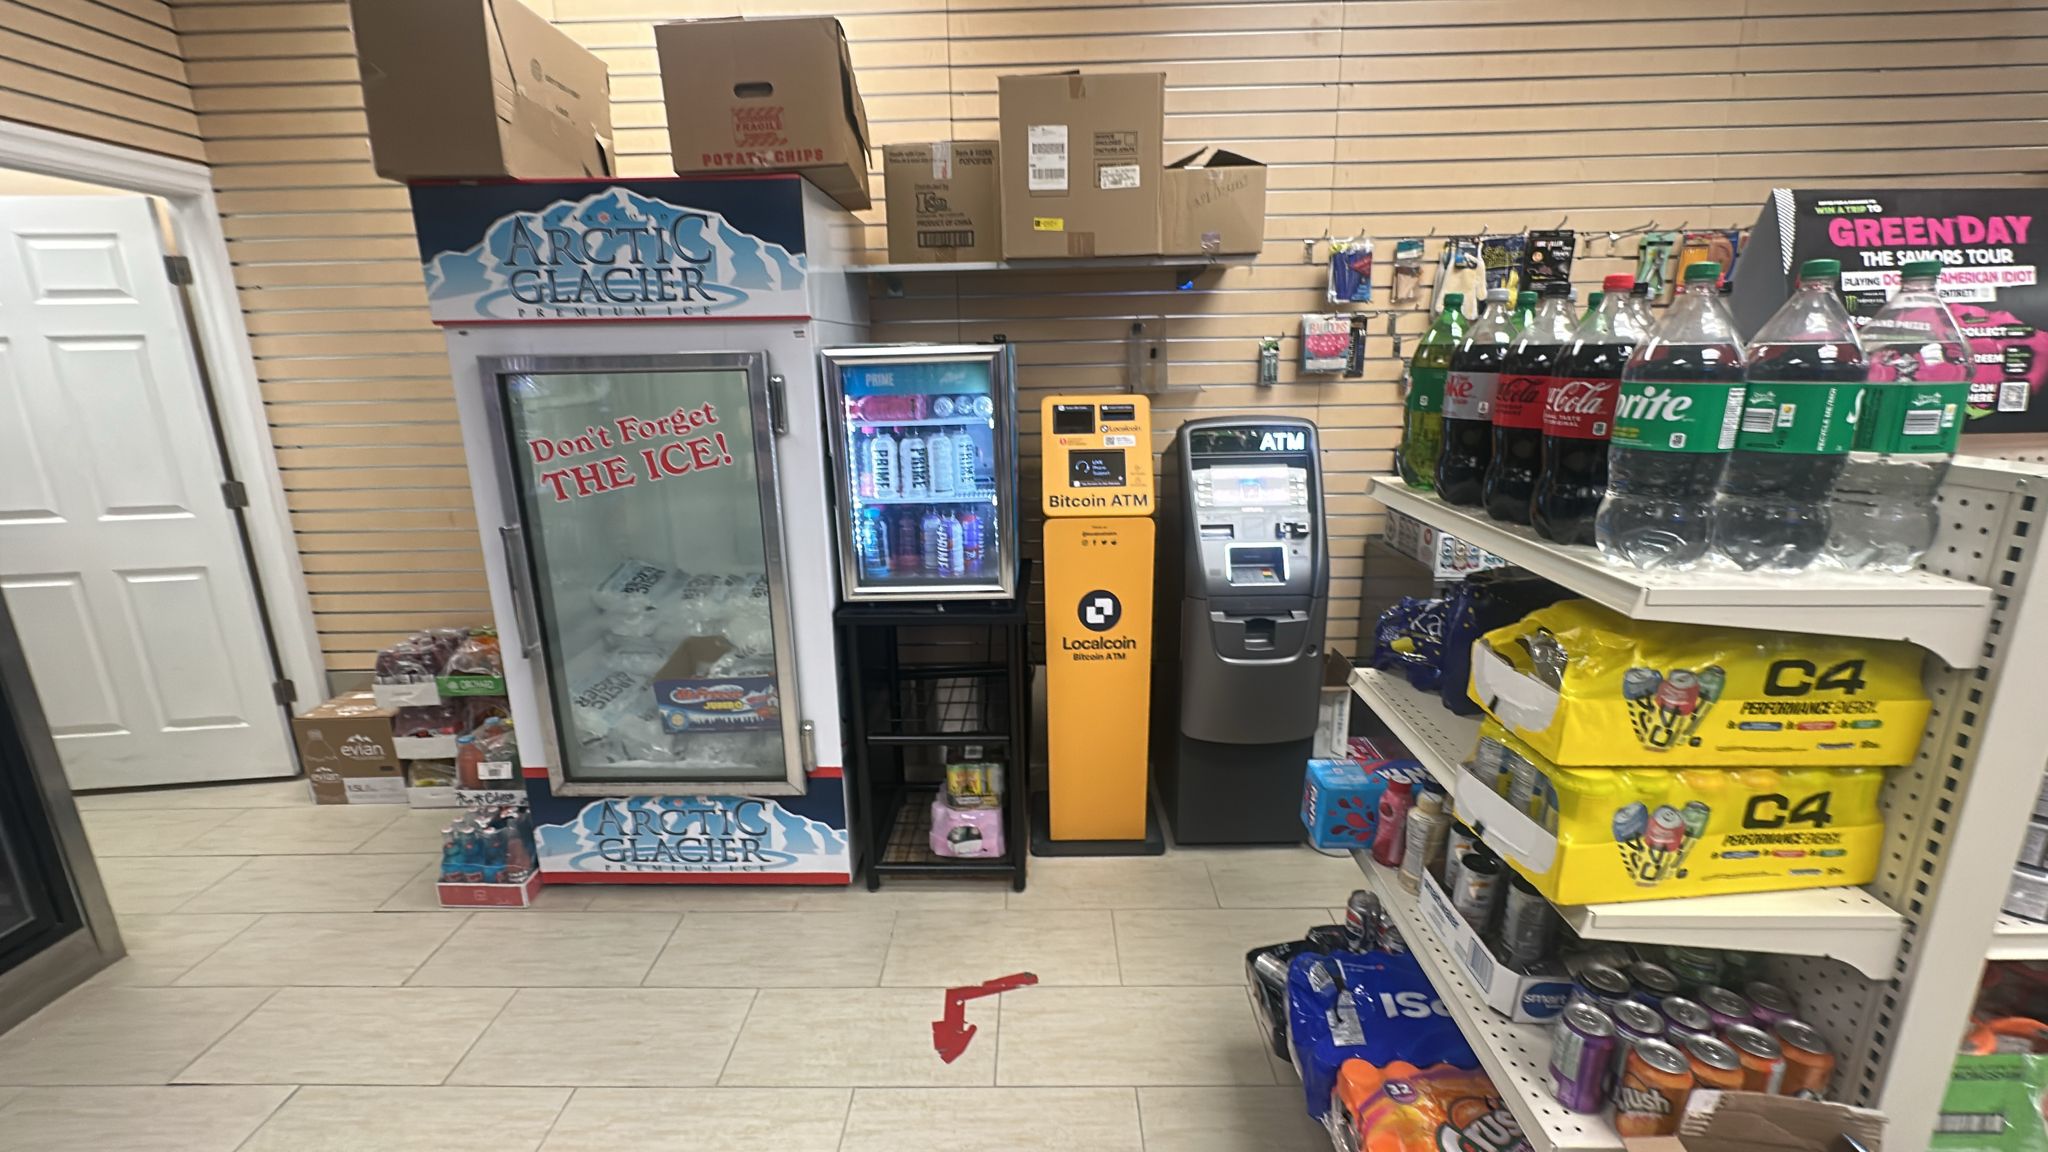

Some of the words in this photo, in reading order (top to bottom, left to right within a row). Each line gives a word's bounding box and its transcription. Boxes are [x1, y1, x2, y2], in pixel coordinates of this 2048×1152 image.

[735, 120, 783, 132] FRAGILE
[774, 148, 823, 163] CHIPS
[1815, 206, 1837, 215] WIN
[1867, 204, 1883, 213] TO
[1828, 217, 1955, 247] GREEN
[1955, 215, 2032, 245] DAY
[503, 213, 713, 266] ARCTIC
[1860, 252, 1893, 267] THE
[1898, 249, 1963, 265] SAVIORS
[1966, 249, 2014, 264] TOUR
[1844, 278, 1881, 287] PLAYING
[1940, 270, 1999, 285] AMERICAN
[2001, 269, 2034, 283] IDIOT
[509, 267, 718, 304] GLACIER
[517, 305, 647, 318] PREMIUM
[666, 304, 713, 316] ICE
[1974, 354, 2005, 364] DEEM
[1969, 384, 1996, 393] CAN
[529, 426, 613, 464] Don't
[614, 401, 720, 445] Forget
[1259, 432, 1306, 451] ATM
[540, 456, 637, 503] THE
[641, 432, 734, 482] ICE!
[874, 449, 891, 489] PRIME
[1049, 495, 1106, 508] Bitcoin
[1112, 495, 1148, 507] ATM
[1062, 636, 1137, 650] Localcoin
[1072, 653, 1104, 661] Bitcoin
[1106, 652, 1126, 660] ATM
[1763, 659, 1867, 697] C4
[1740, 702, 1831, 715] PERFORMANCE
[341, 744, 384, 757] evian
[311, 773, 342, 783] evian
[1741, 790, 1834, 830] C4
[594, 801, 768, 836] ARCTIC
[1722, 833, 1805, 847] PERFORMANCE
[600, 838, 771, 864] GLACIER
[605, 864, 714, 874] PREMIUM
[730, 864, 768, 874] ICE
[1385, 1083, 1414, 1097] 32
